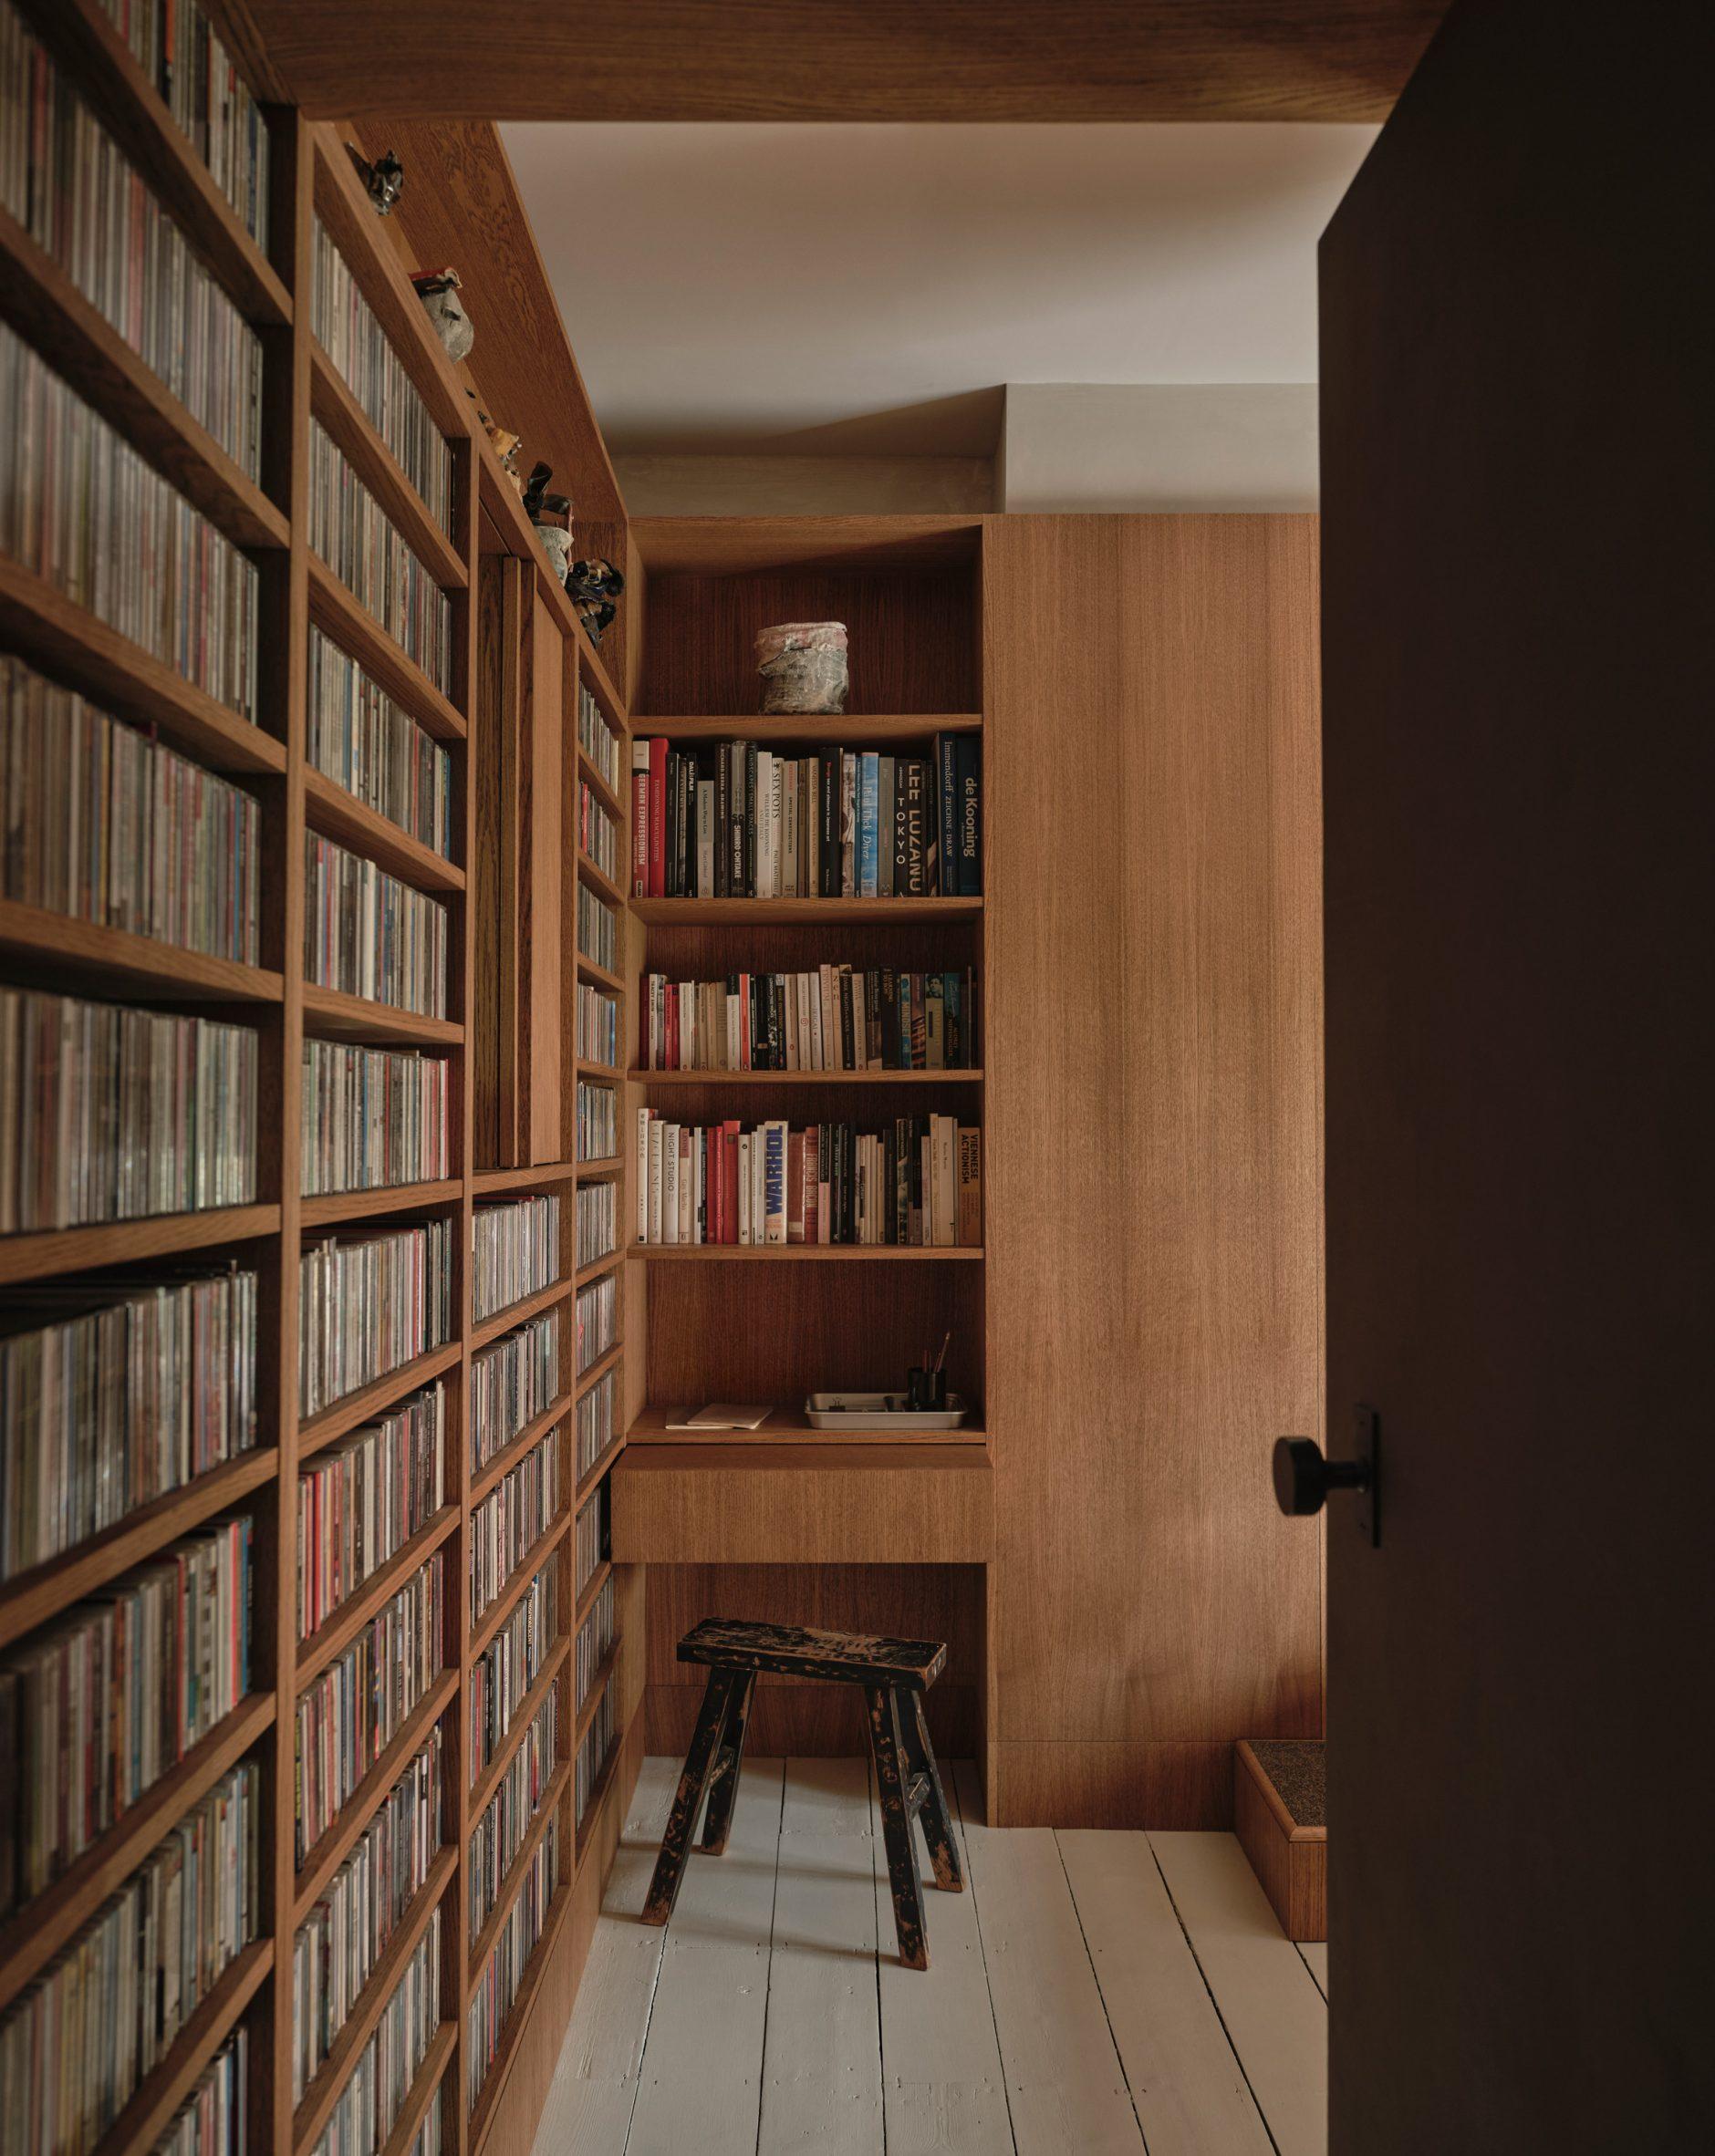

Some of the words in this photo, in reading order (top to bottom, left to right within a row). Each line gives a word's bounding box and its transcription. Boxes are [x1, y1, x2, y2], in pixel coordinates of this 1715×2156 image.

[944, 741, 953, 793] Immendorff
[638, 773, 646, 803] GERMAN
[862, 787, 872, 806] Paul
[909, 765, 921, 800] LEE
[965, 777, 978, 794] de
[863, 810, 872, 831] Thek
[897, 798, 906, 865] TOKYO
[963, 798, 978, 857] Kooning
[638, 806, 646, 866] EXPRESSIONISM
[733, 824, 742, 849] SHINRO
[862, 835, 871, 859] Diver
[733, 851, 742, 878] OHTAKE
[822, 969, 830, 1001] TRIVIUM
[766, 1125, 783, 1216] WARHOL
[806, 1153, 817, 1182] FRANCIS
[806, 1185, 817, 1208] BACON
